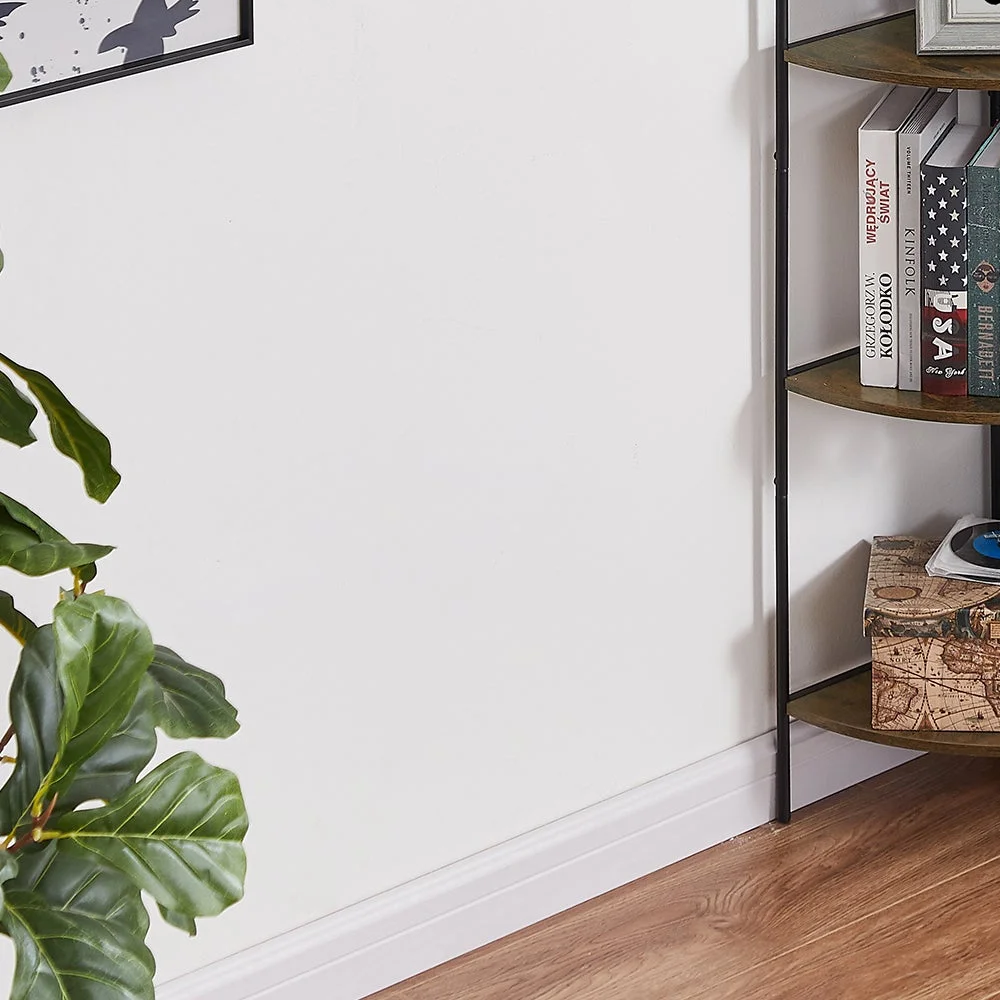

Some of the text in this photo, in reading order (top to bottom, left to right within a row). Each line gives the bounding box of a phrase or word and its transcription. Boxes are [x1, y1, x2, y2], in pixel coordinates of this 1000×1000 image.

[865, 159, 878, 244] WĘDRUJĄCY
[877, 181, 890, 223] ŚWIAT
[904, 228, 915, 296] KINFOLK
[865, 272, 876, 358] GRZEGORZ W.
[879, 273, 892, 359] KOŁODKO
[932, 293, 953, 360] USA
